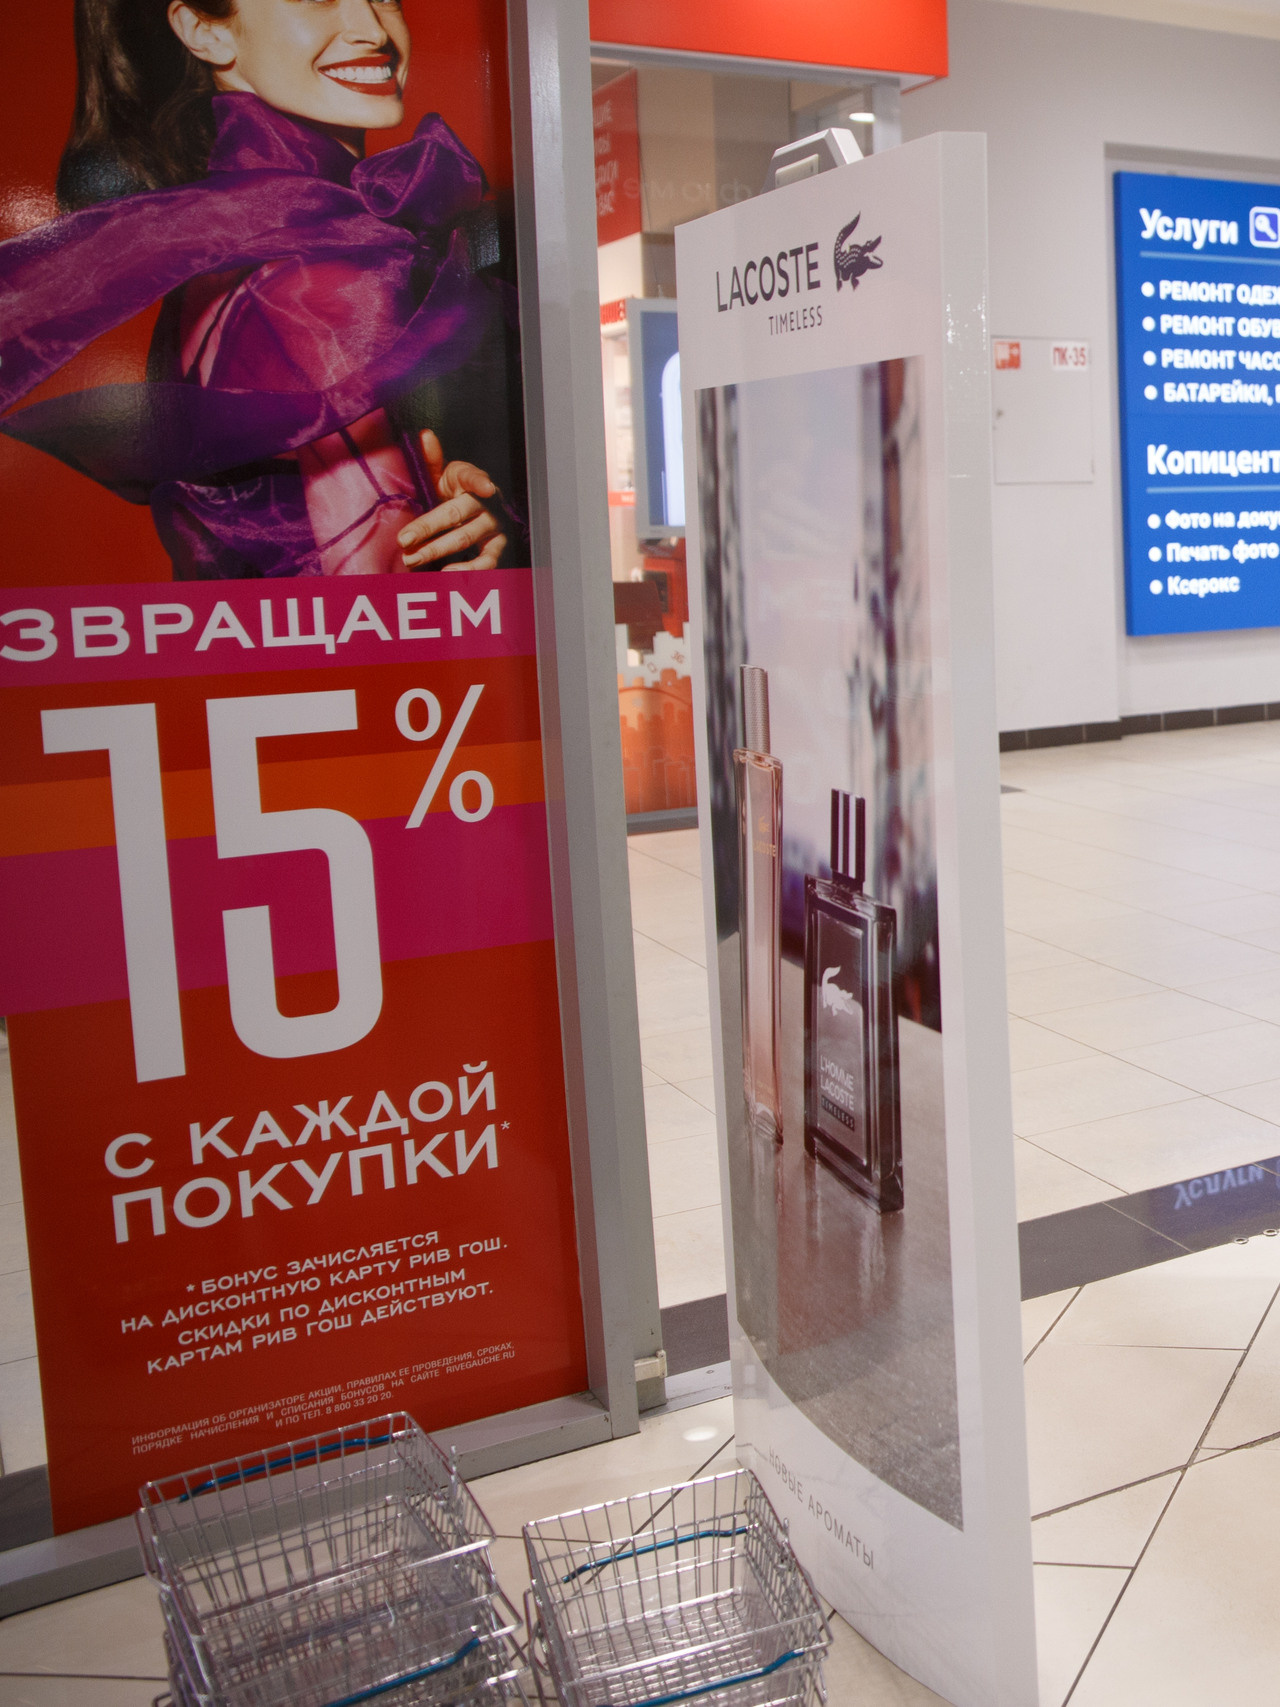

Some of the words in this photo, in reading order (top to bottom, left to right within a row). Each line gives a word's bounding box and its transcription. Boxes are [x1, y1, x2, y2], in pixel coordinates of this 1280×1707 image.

[1139, 207, 1239, 250] Услуги
[716, 242, 821, 313] LACOSTE
[1159, 279, 1235, 303] РЕМОНТ
[769, 305, 823, 336] TIMELESS
[1160, 314, 1236, 336] РЕМОНТ
[1161, 348, 1237, 370] РЕМОНТ
[1163, 379, 1273, 406] БАТАРЕЙКИ,
[1165, 509, 1212, 529] Фото
[1212, 512, 1236, 528] на
[1166, 542, 1231, 563] Печать
[1232, 539, 1280, 564] фото
[1167, 575, 1241, 598] Ксерокс
[0, 588, 502, 662] ЗВРАЩАЕМ
[820, 1055, 854, 1092] L'HOMME
[820, 1074, 855, 1111] LACOSTE
[104, 1131, 156, 1179] С
[189, 1061, 497, 1166] КАЖДОЙ
[286, 1231, 439, 1276] ЗАЧИСЛЯЕТСЯ
[121, 1314, 154, 1334] НА
[161, 1276, 321, 1328] ДИСКОНТНУЮ
[330, 1258, 401, 1288] КАРТУ
[409, 1248, 450, 1269] РИВ
[459, 1237, 508, 1258] ГОШ.
[177, 1312, 270, 1345] СКИДКИ
[280, 1304, 310, 1323] ПО
[318, 1268, 466, 1316] ДИСКОНТНЫМ
[147, 1339, 243, 1375] КАРТАМ
[252, 1326, 298, 1350] РИВ
[306, 1313, 352, 1337] ГОШ
[360, 1281, 494, 1327] ДЕЙСТВУЮТ.
[131, 1417, 210, 1446] ИНФОРМАЦИЯ
[212, 1413, 226, 1424] ОБ
[229, 1393, 306, 1420] ОРГАНИЗАТОРЕ
[346, 1369, 397, 1390] ПРАВИЛАХ
[399, 1367, 411, 1377] ЕЕ
[132, 1434, 184, 1456] ПОРЯДКЕ
[190, 1415, 260, 1440] НАЧИСЛЕНИЯ
[266, 1411, 274, 1421] И
[280, 1396, 334, 1416] СПИСАНИЯ
[341, 1383, 385, 1401] БОНУСОВ
[391, 1379, 404, 1388] НА
[410, 1368, 440, 1384] САЙТЕ
[446, 1350, 516, 1374] RIVEGAUCHE.RU
[275, 1418, 283, 1428] И
[285, 1414, 300, 1425] ПО
[302, 1408, 324, 1421] ТЕЛ.
[325, 1406, 332, 1415] 8
[334, 1402, 351, 1413] 800
[353, 1398, 365, 1408] 33
[367, 1394, 378, 1404] 20
[768, 1445, 804, 1504] НОВЫЕ
[807, 1494, 875, 1570] АРОМАТЫ
